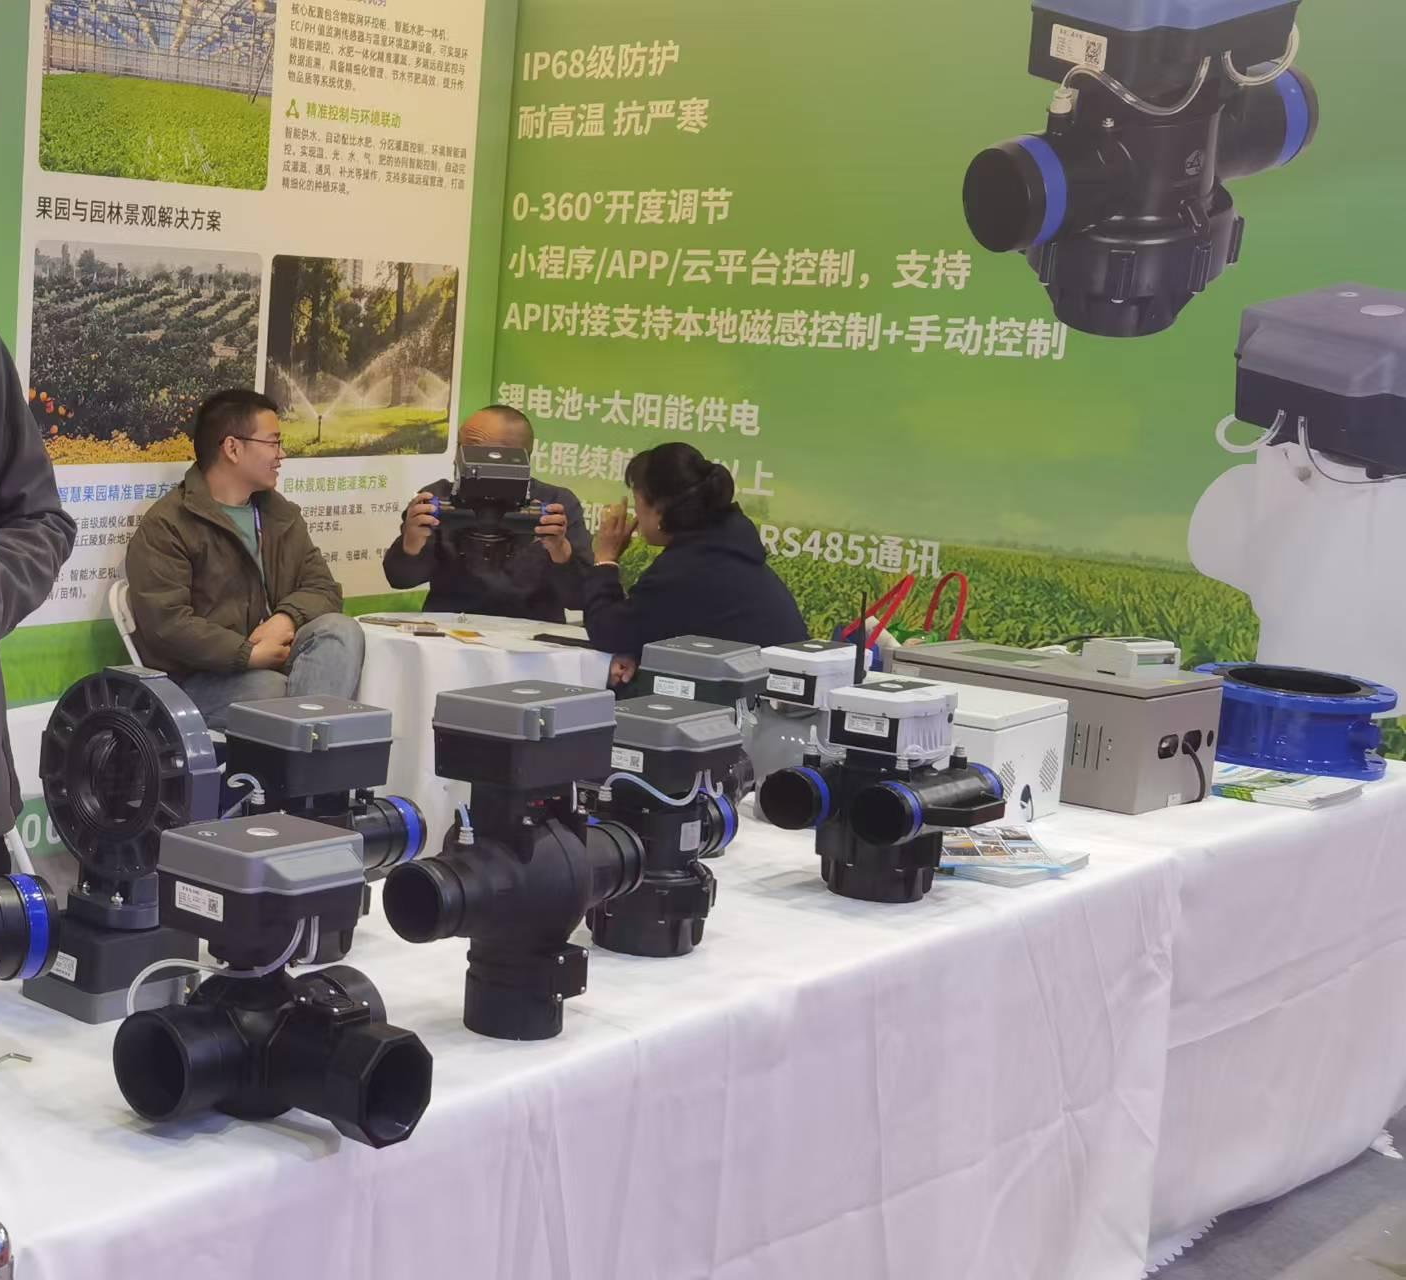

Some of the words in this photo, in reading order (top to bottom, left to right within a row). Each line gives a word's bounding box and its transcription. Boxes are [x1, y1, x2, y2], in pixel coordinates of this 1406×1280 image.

[522, 39, 681, 82] IP68级防护
[306, 102, 402, 129] 精准控制与环境联动
[517, 103, 606, 141] 耐高温
[612, 96, 711, 137] 抗严寒
[35, 196, 222, 232] 果园与园林景观解决方案
[512, 187, 734, 225] 0-360°开度调节
[503, 301, 1067, 361] API对接支持本地磁感控制+手动控制
[58, 483, 180, 503] 智慧果园精准管理方
